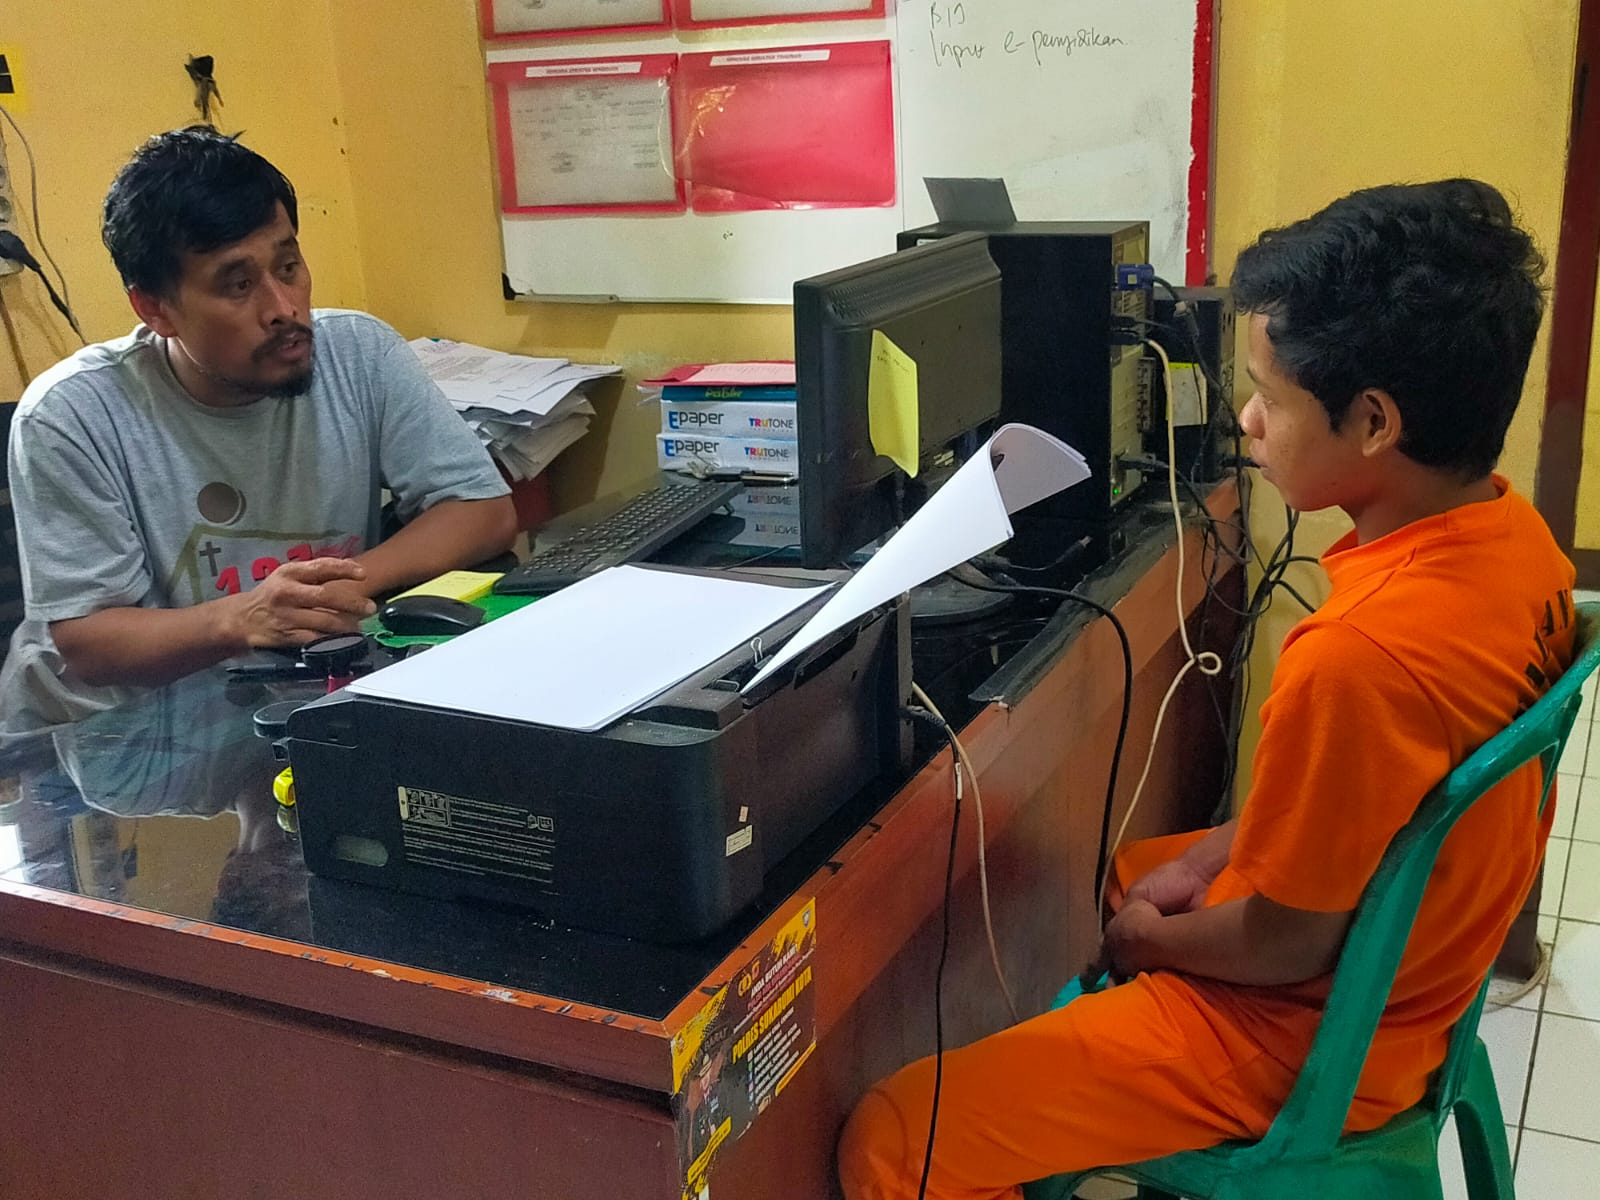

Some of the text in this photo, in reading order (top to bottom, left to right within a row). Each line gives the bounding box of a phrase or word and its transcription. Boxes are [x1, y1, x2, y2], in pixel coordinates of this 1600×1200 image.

[668, 411, 724, 429] Epaper
[749, 418, 793, 429] TRUTONE
[664, 439, 720, 457] Epaper
[744, 447, 790, 458] TRUTONE
[733, 1022, 759, 1064] POLRES
[759, 983, 795, 1034] SUKABUMI
[795, 965, 812, 996] KOTA
